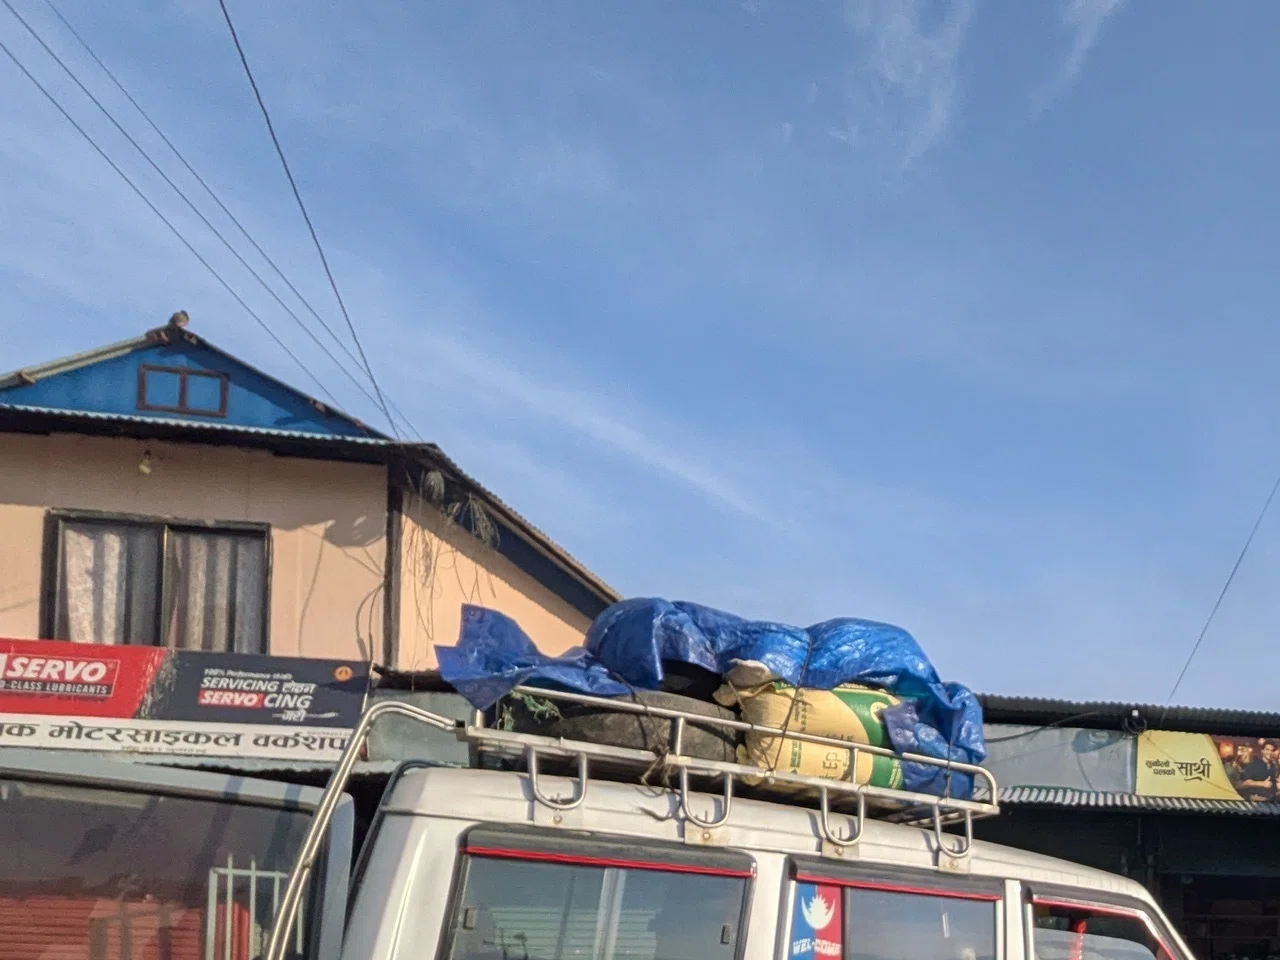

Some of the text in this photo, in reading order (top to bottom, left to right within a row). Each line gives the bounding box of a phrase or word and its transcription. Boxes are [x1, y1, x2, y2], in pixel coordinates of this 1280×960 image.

[6, 657, 107, 682] SERVO
[46, 682, 109, 694] LUBRICANTS
[201, 677, 280, 692] SERVICING
[201, 690, 313, 709] SERVO CING
[48, 720, 243, 747] मोटरसाइकल
[1174, 758, 1212, 780] साथी
